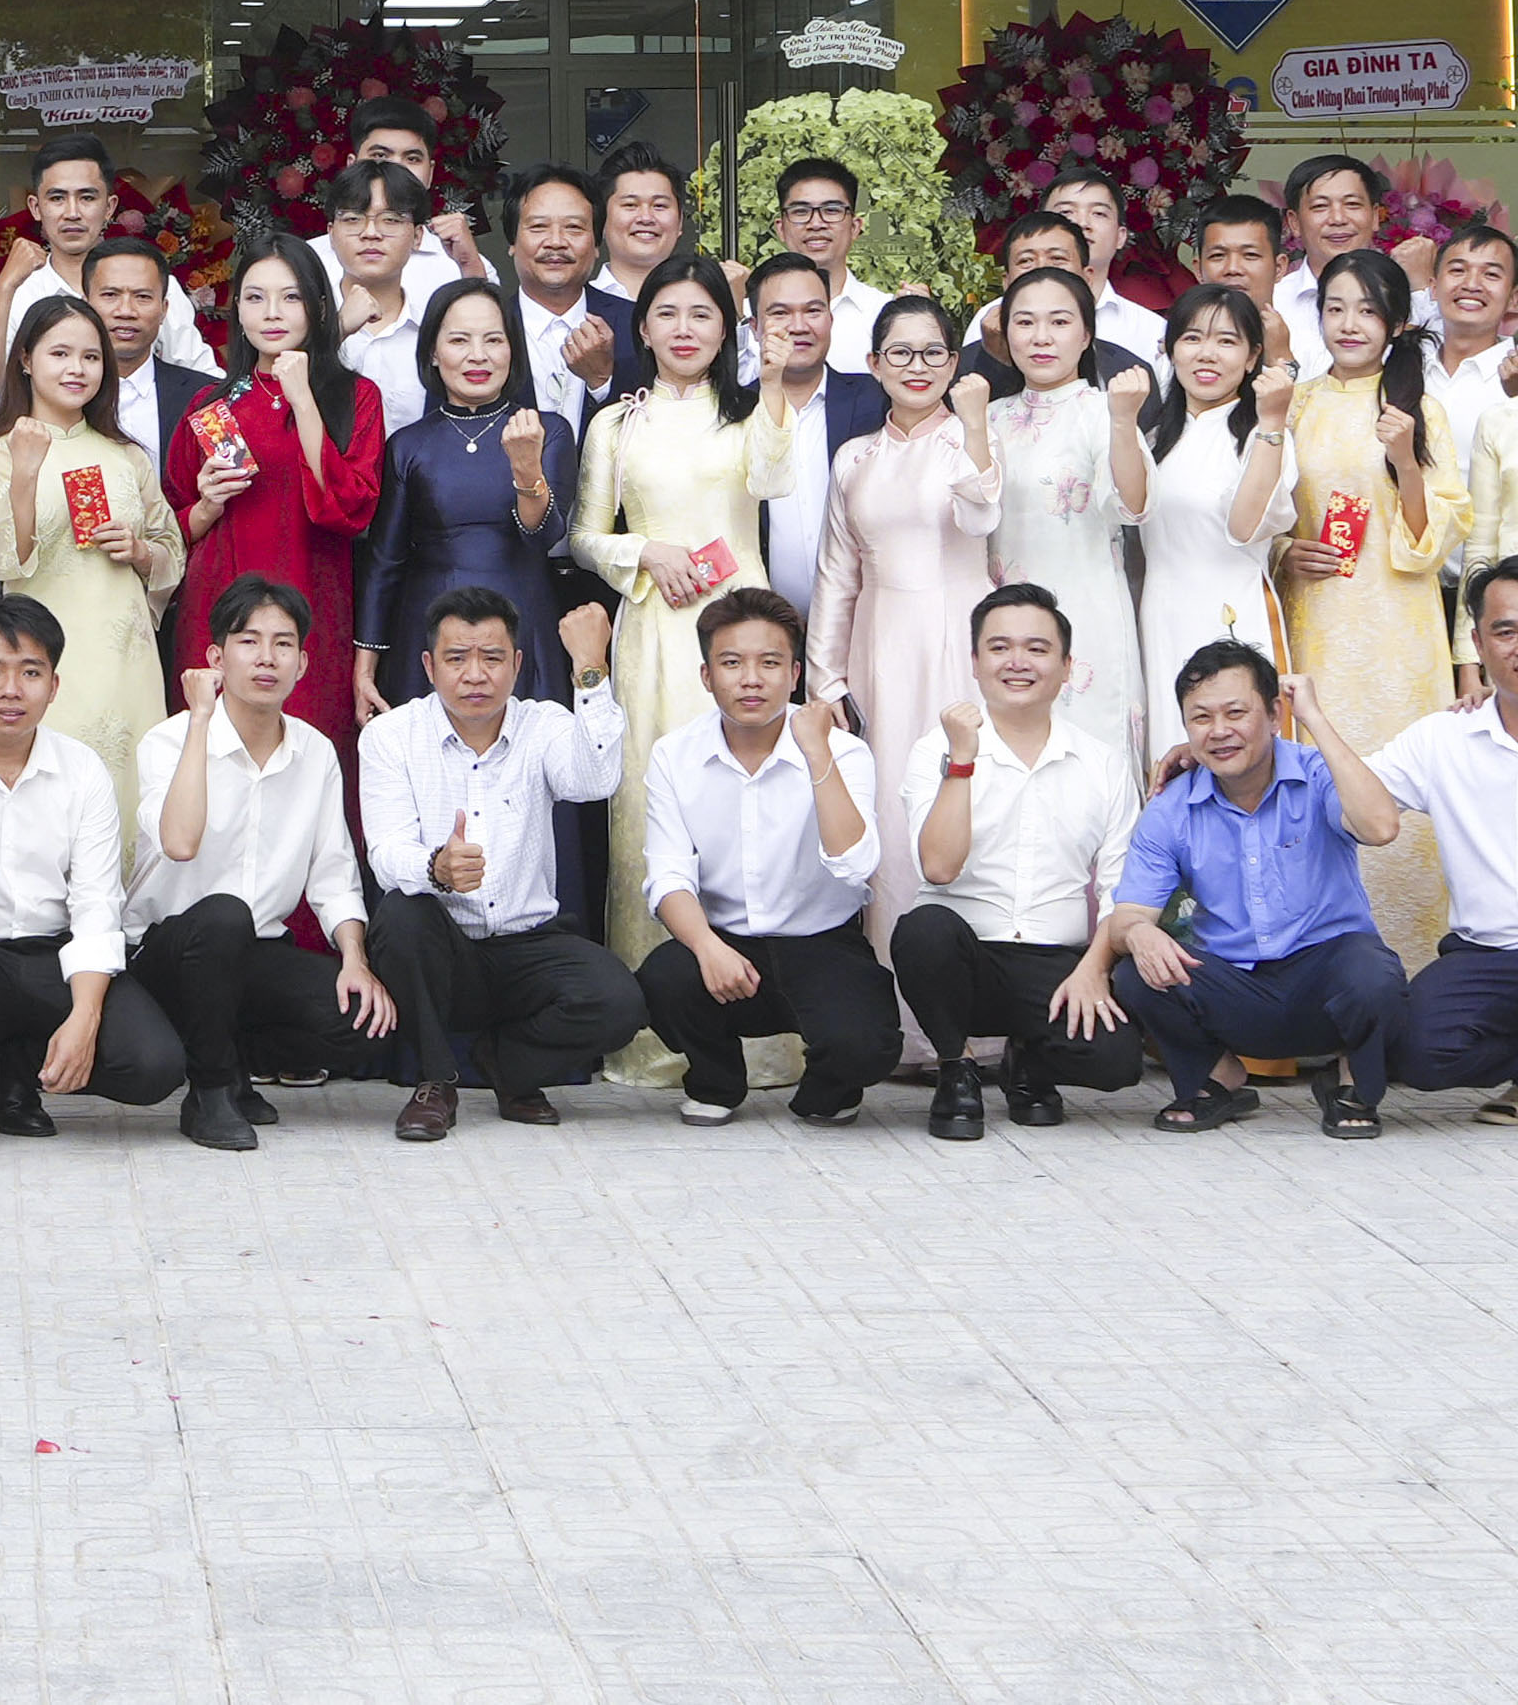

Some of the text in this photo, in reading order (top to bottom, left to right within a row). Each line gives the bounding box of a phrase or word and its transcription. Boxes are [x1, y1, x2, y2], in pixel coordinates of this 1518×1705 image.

[1303, 51, 1437, 78] GIA ĐÌNH TA
